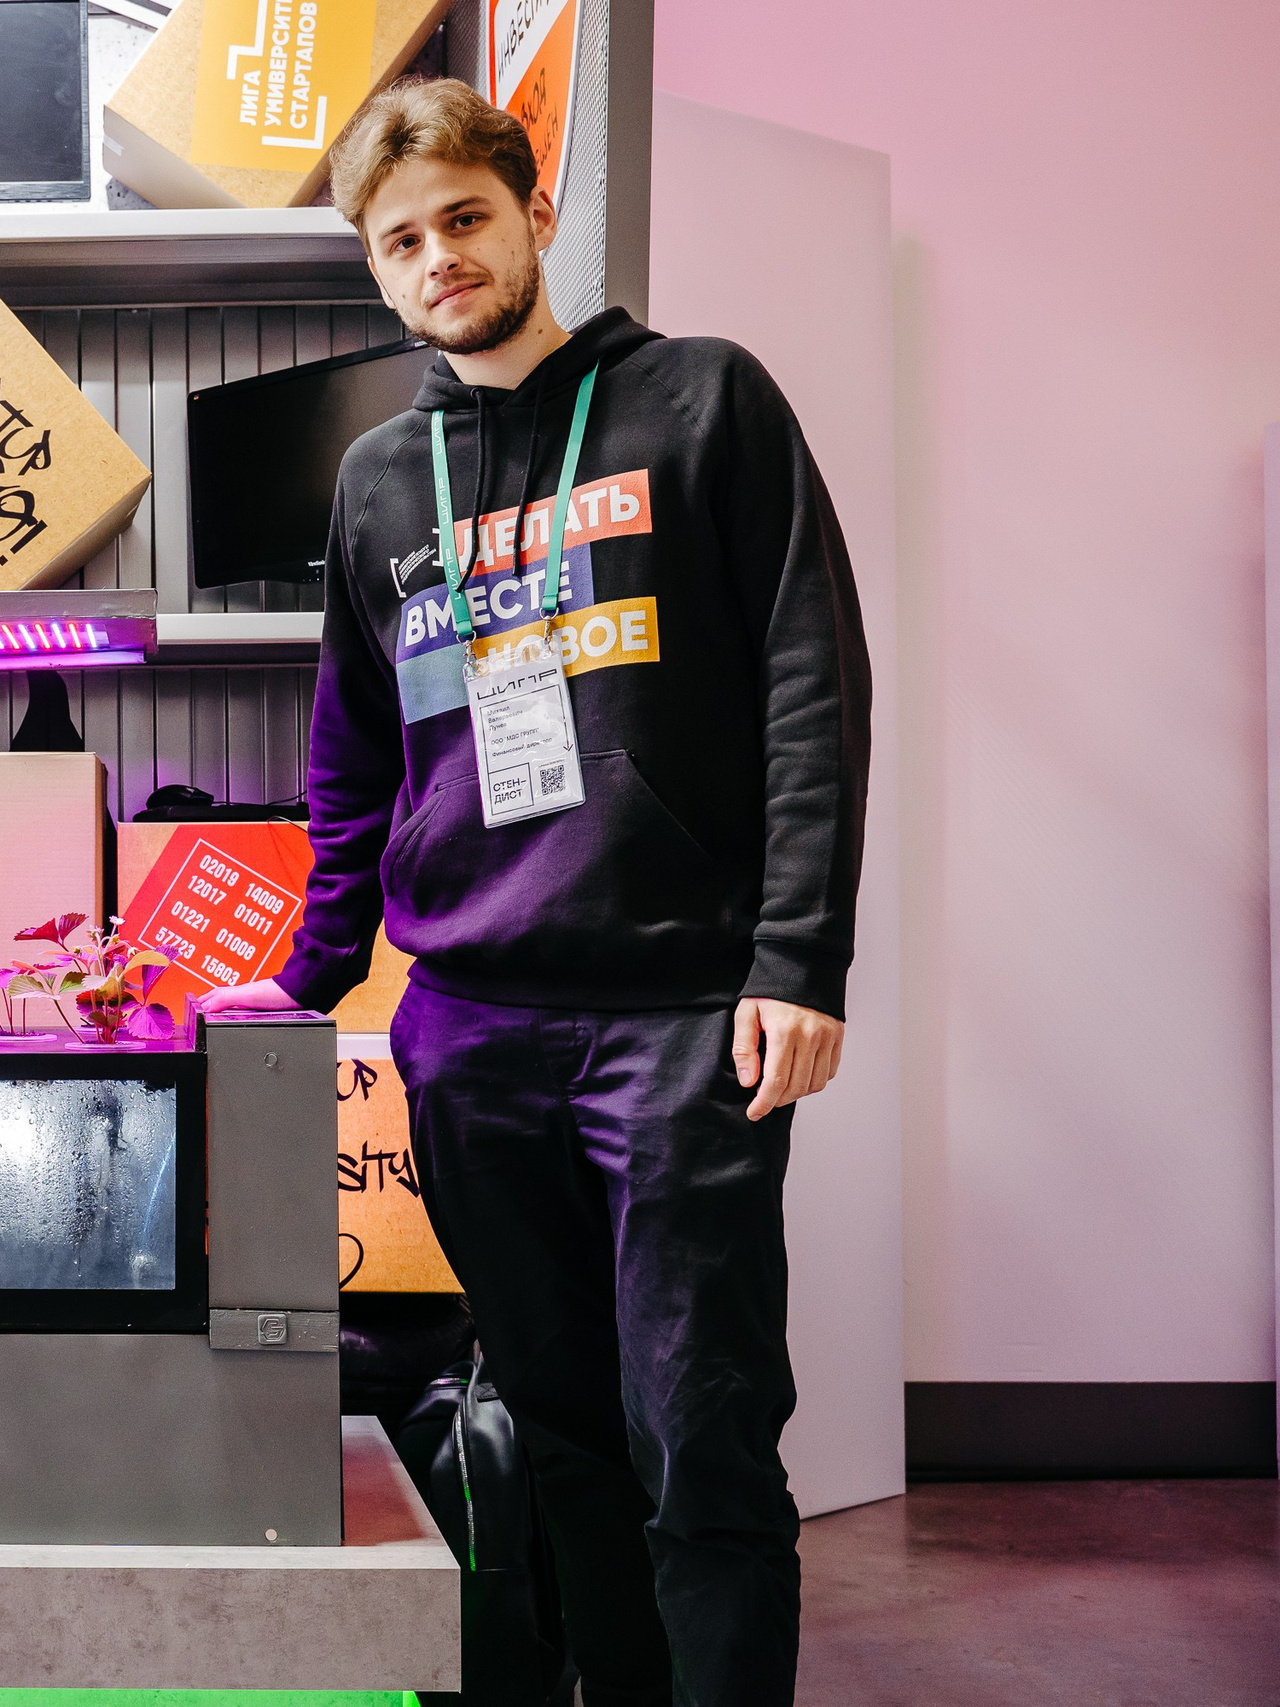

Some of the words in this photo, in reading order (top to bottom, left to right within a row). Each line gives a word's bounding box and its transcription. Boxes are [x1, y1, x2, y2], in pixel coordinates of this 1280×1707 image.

[264, 0, 293, 126] УНИВЕРСИТ
[289, 2, 318, 129] СТАРТАПОВ
[239, 70, 261, 126] ЛИГА
[404, 560, 573, 647] ВМЕСТЕ
[494, 789, 522, 805] ДИСТ
[187, 875, 227, 906] 12017
[233, 903, 273, 935] 01011
[199, 854, 240, 887] 02019
[245, 882, 284, 915] 14009
[171, 901, 211, 933] 01221
[215, 928, 256, 961] 01008
[200, 954, 241, 986] 15803
